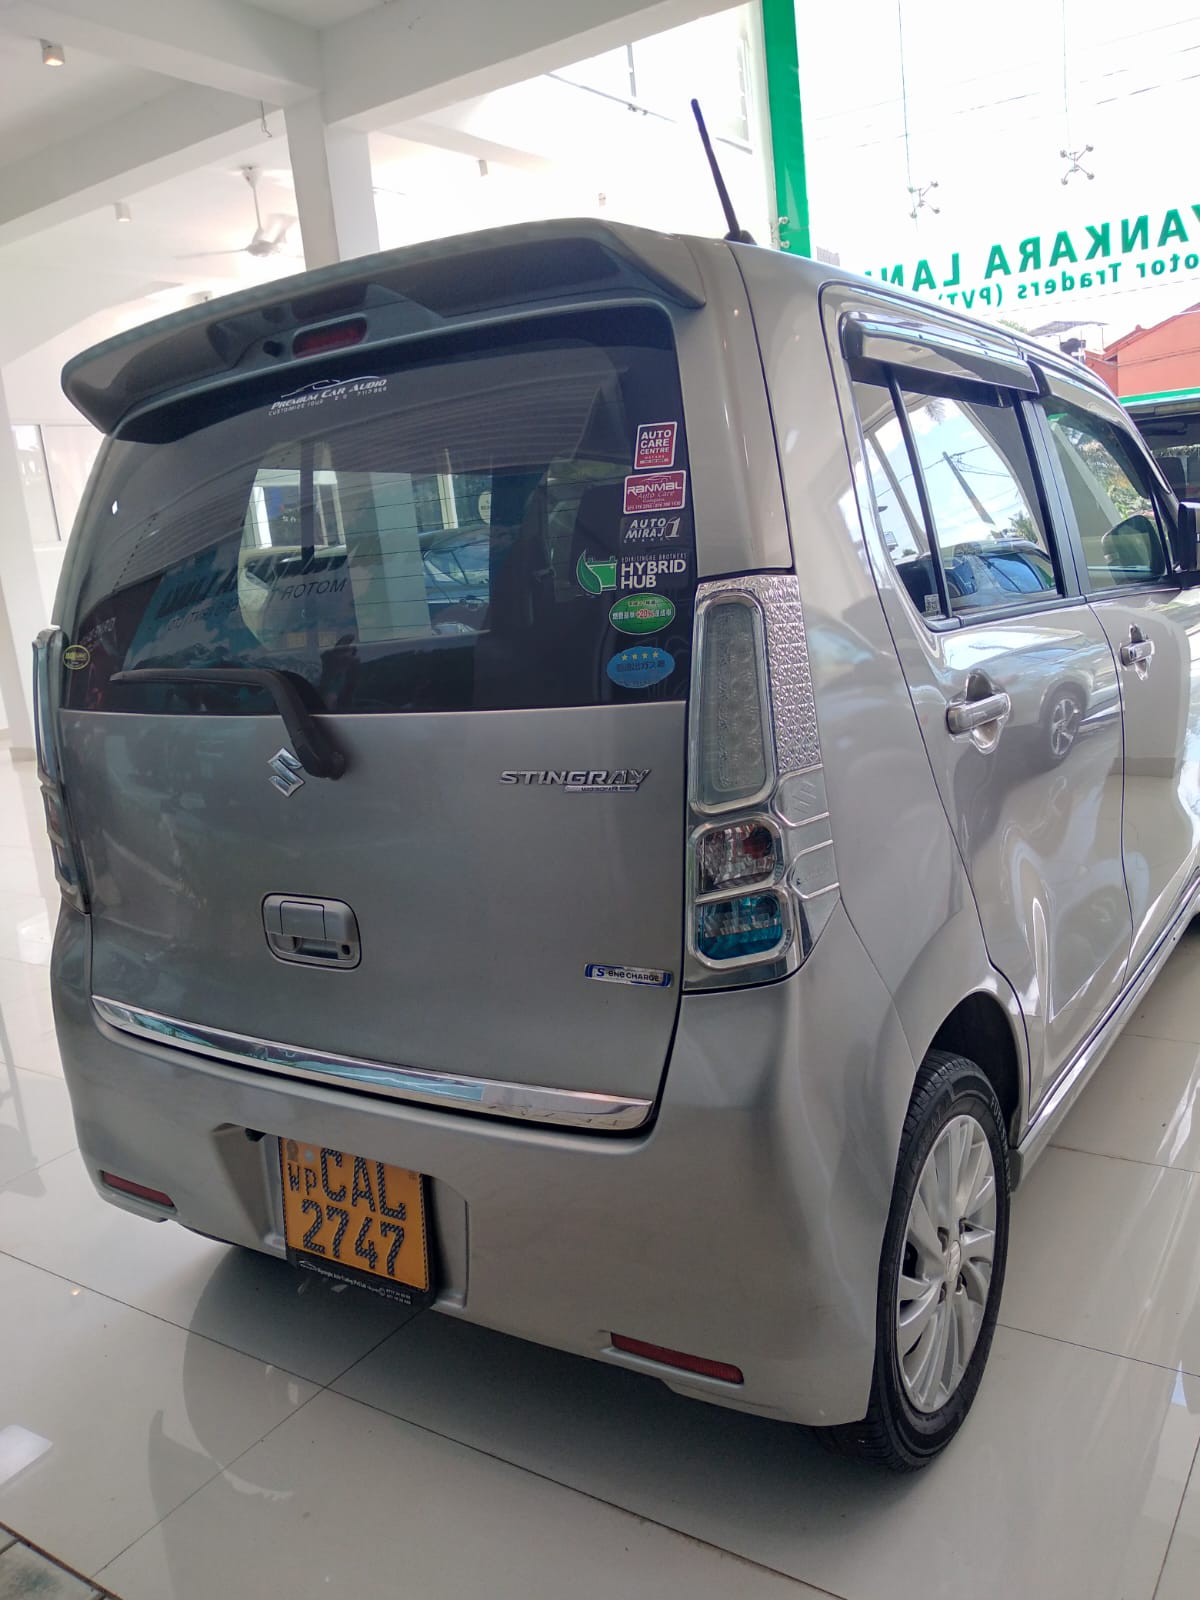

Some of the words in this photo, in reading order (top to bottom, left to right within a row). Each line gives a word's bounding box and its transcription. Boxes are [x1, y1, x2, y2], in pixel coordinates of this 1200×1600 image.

[321, 387, 346, 398] CAR
[349, 379, 387, 392] AUDIO
[641, 429, 672, 440] AUTO
[640, 438, 670, 449] CARE
[640, 446, 670, 455] CENTRE
[630, 518, 667, 529] AUTO
[625, 527, 665, 539] MIRAJ
[621, 559, 687, 576] HYBRID
[620, 575, 657, 590] HUB
[498, 769, 651, 786] STINGRAY
[287, 1163, 317, 1195] WP
[320, 1148, 407, 1221] CAL
[301, 1199, 405, 1276] 2747
